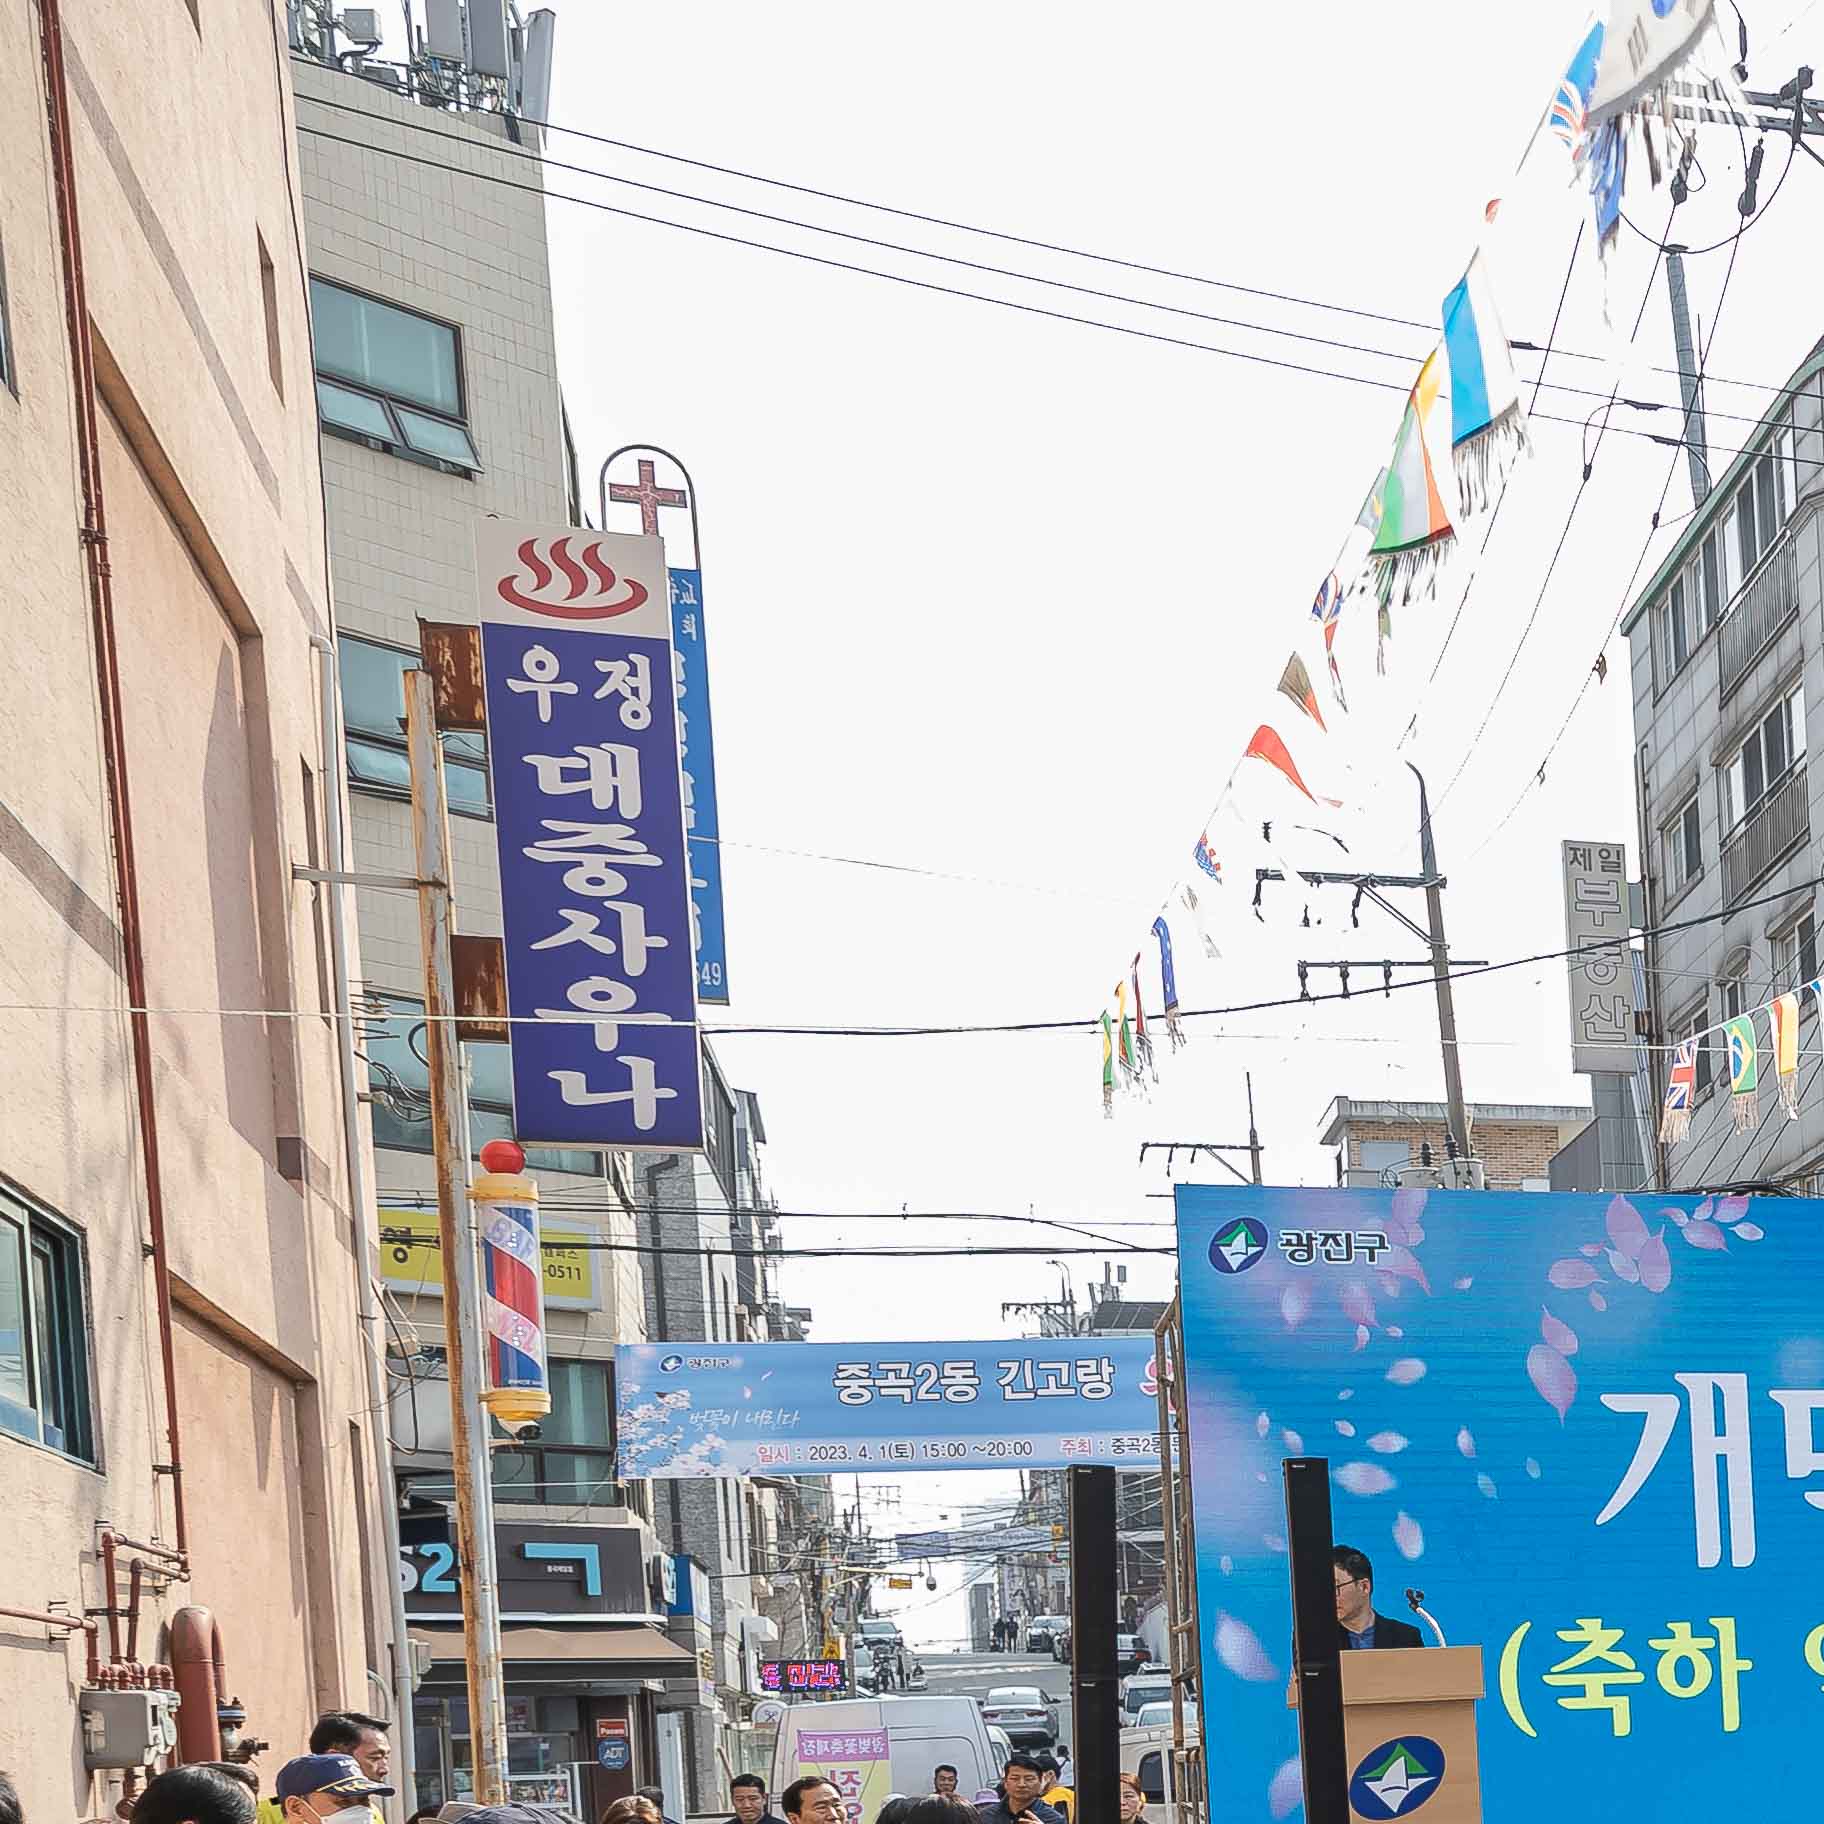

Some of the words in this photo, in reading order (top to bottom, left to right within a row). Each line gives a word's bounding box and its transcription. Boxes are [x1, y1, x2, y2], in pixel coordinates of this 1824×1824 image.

[505, 643, 653, 731] 우정
[1569, 846, 1622, 873] 제일
[520, 742, 678, 1131] 대중사우나
[1574, 877, 1631, 1042] 부동산
[1279, 1230, 1390, 1264] 광진구
[832, 1359, 981, 1407] 중곡2동
[997, 1356, 1116, 1402] 긴고랑
[758, 1444, 790, 1463] 일시
[808, 1445, 852, 1461] 2023.
[858, 1444, 873, 1460] 4.
[922, 1442, 967, 1458] 15:00
[1062, 1438, 1093, 1457] 주최
[1500, 1615, 1754, 1738] (축하
